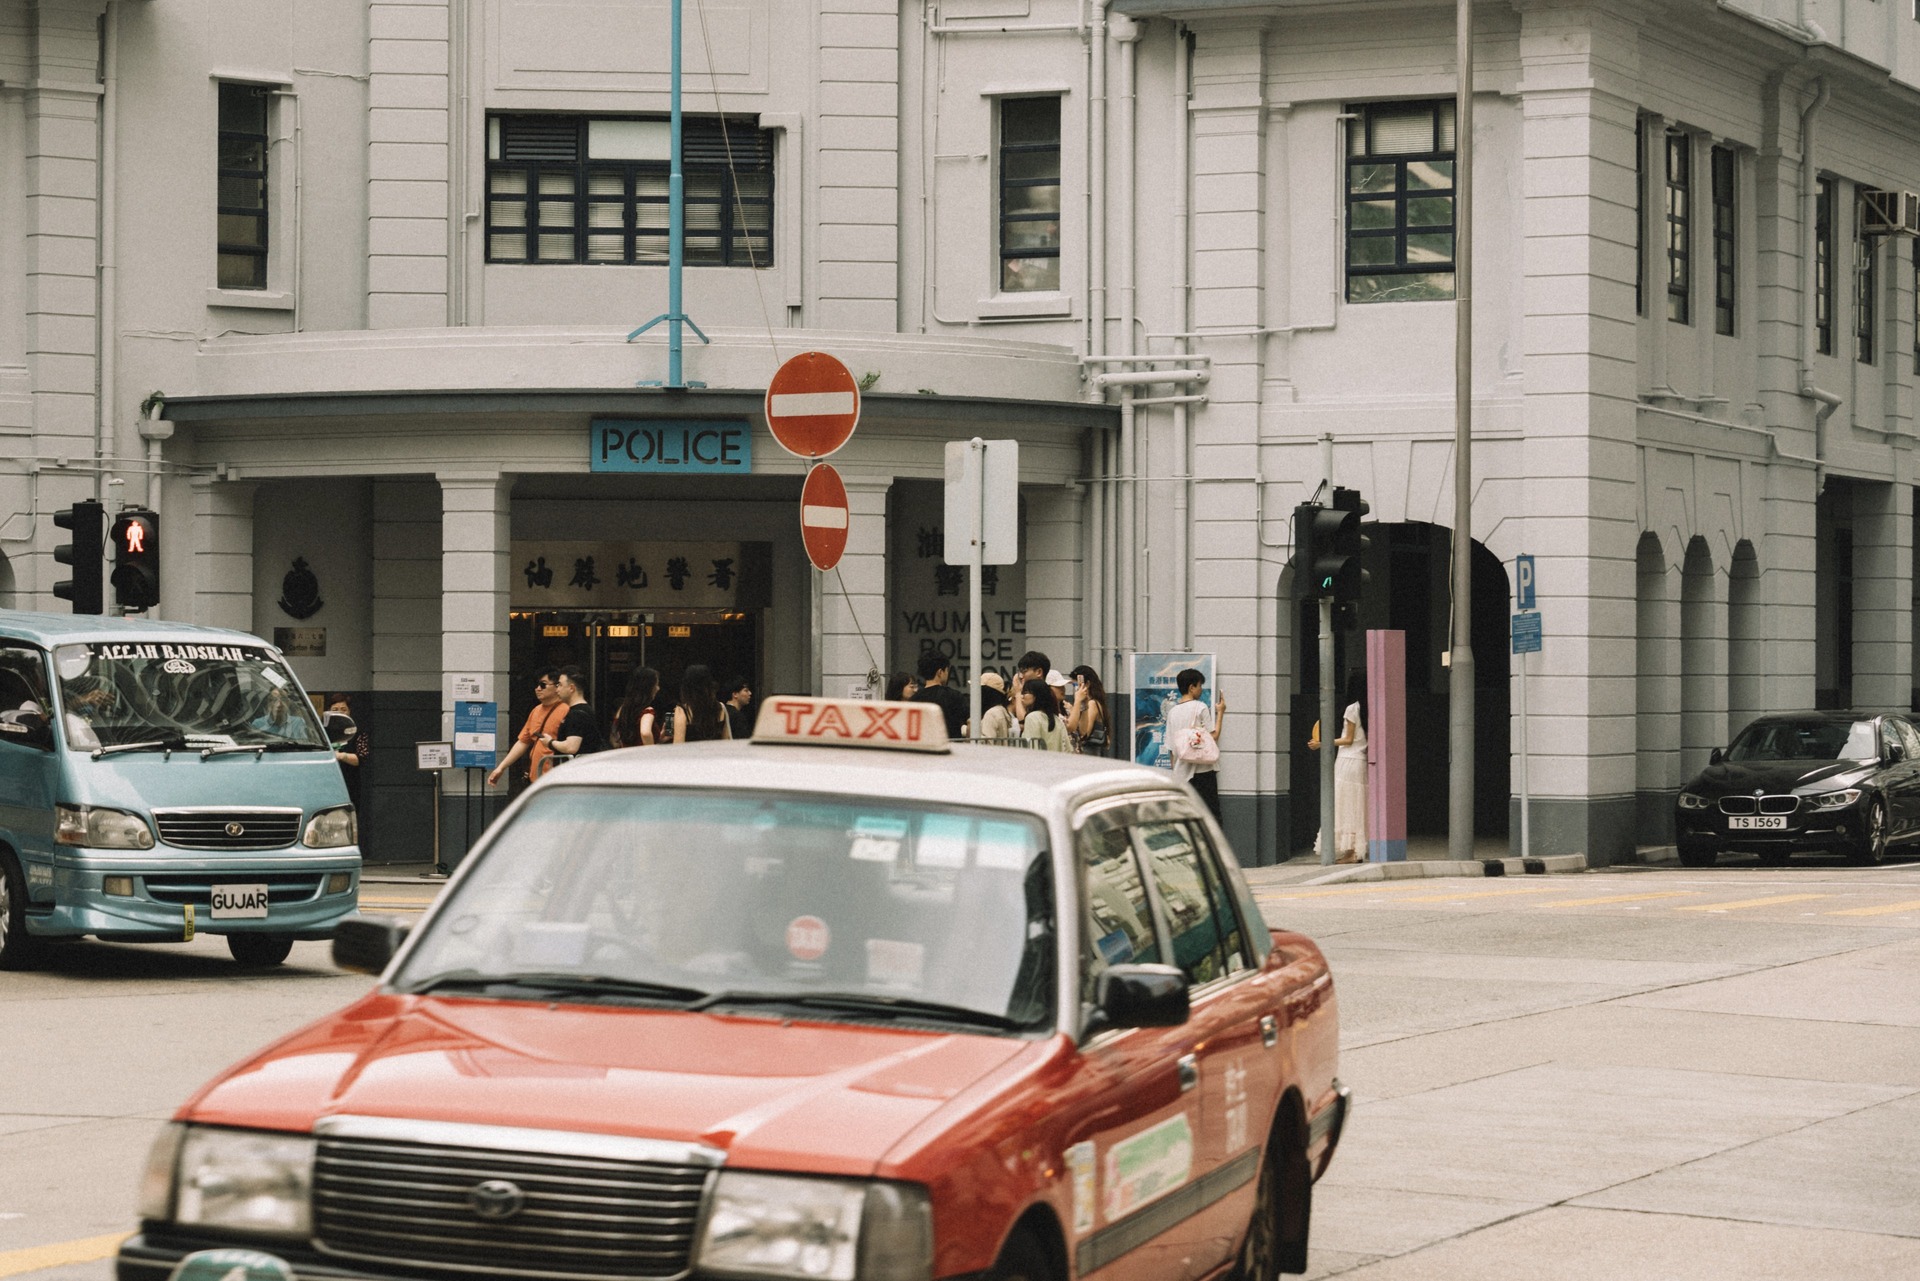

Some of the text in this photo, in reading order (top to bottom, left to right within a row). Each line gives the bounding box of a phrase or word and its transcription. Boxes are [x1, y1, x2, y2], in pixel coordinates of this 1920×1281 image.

[602, 428, 742, 465] POLICE
[1520, 561, 1532, 604] P
[902, 611, 947, 633] YAU
[99, 644, 244, 661] ALLAH BADSHAH
[920, 638, 1013, 660] POLCE
[776, 702, 922, 741] TAXI
[1734, 817, 1781, 828] TS 1569
[212, 893, 267, 909] GUJAR
